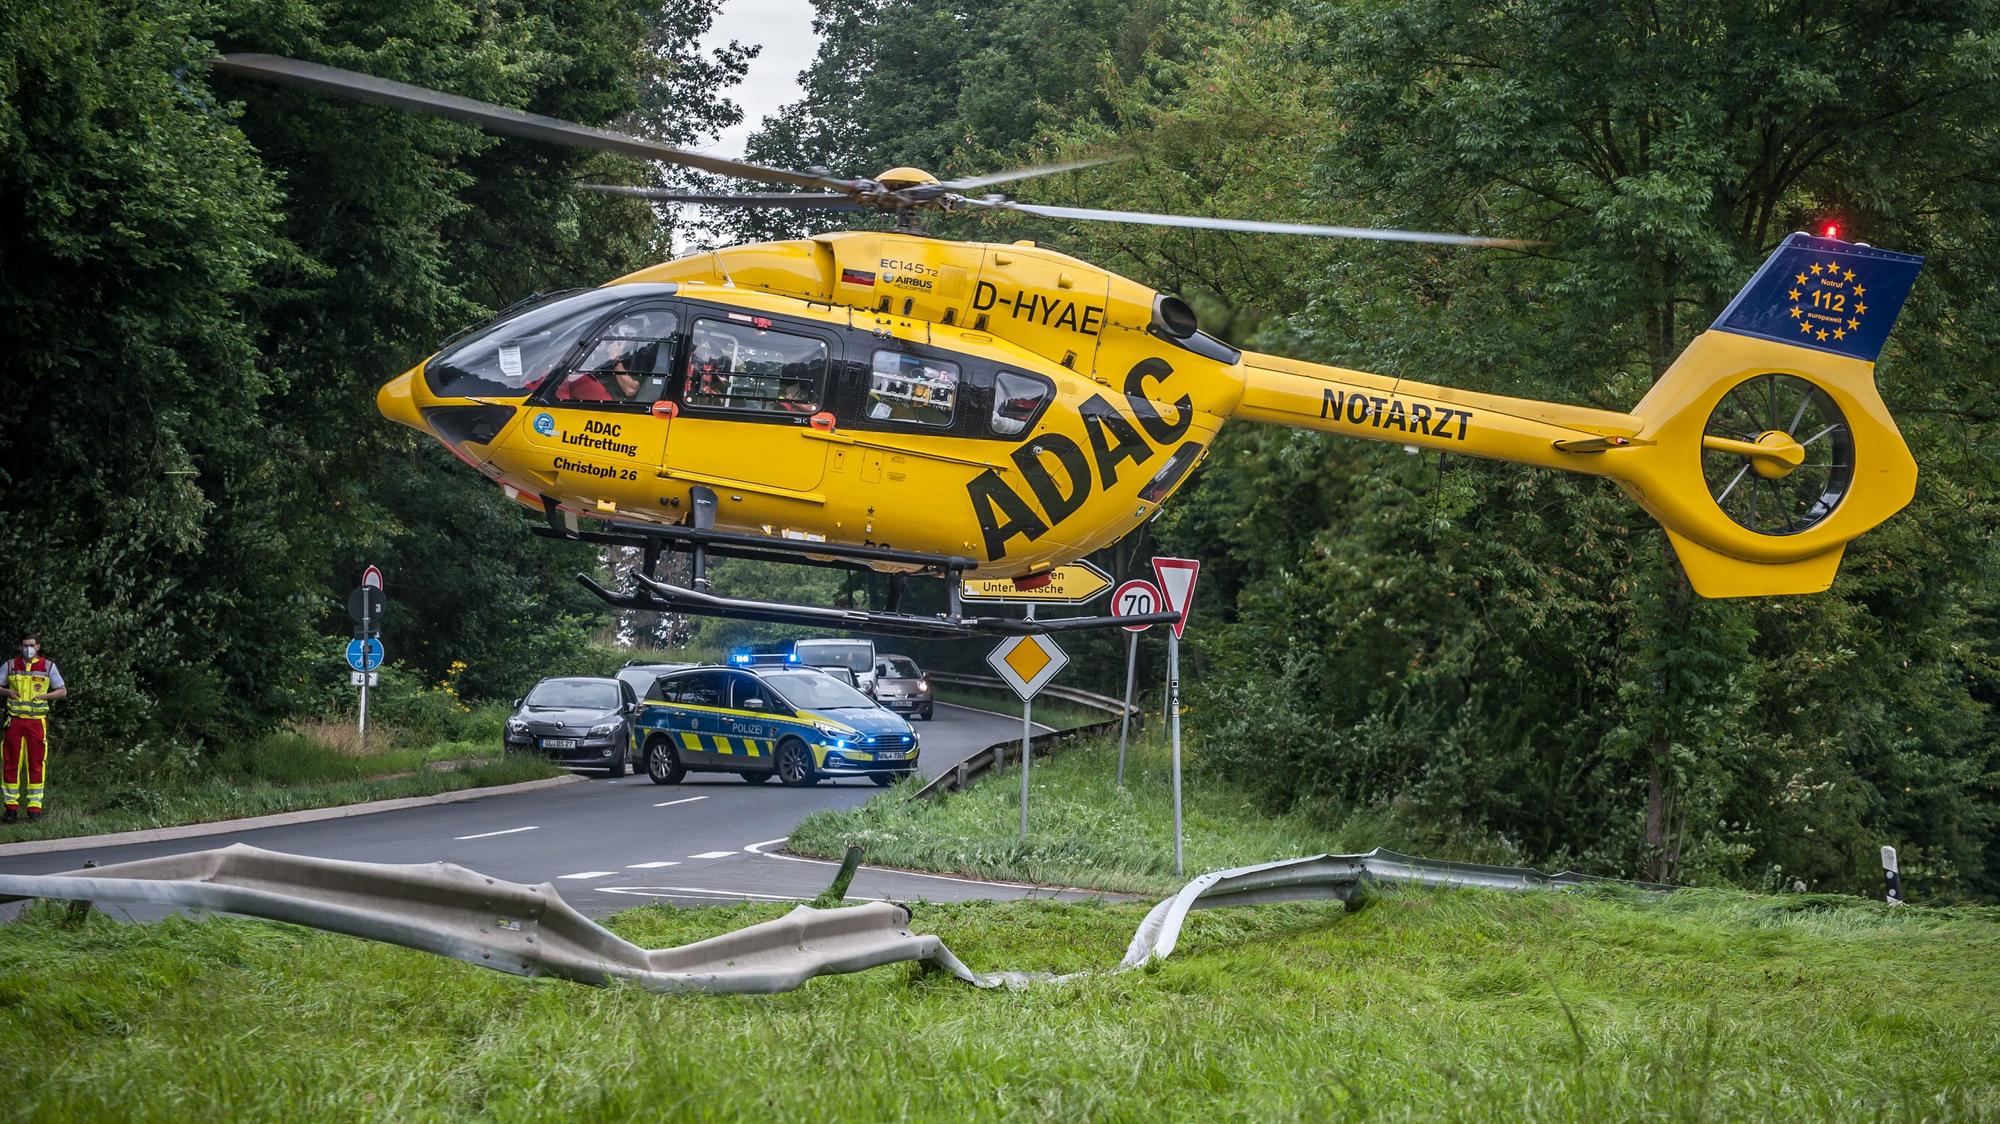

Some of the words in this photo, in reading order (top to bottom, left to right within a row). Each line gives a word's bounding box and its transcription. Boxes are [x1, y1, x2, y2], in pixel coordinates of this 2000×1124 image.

[893, 284, 931, 295] HELICOPTERS
[895, 275, 933, 289] AIRBUS
[1820, 278, 1844, 288] Notruf
[972, 280, 1104, 336] D-HYAE
[1812, 290, 1845, 312] 112
[1807, 312, 1842, 323] europaweit
[1320, 388, 1473, 441] NOTARZT
[584, 420, 621, 437] ADAC
[562, 430, 638, 457] Luftrettung
[553, 456, 617, 478] Christoph
[620, 469, 638, 481] 26
[966, 356, 1193, 562] ADAC
[1124, 594, 1150, 615] 70
[732, 722, 763, 735] POLIZEI
